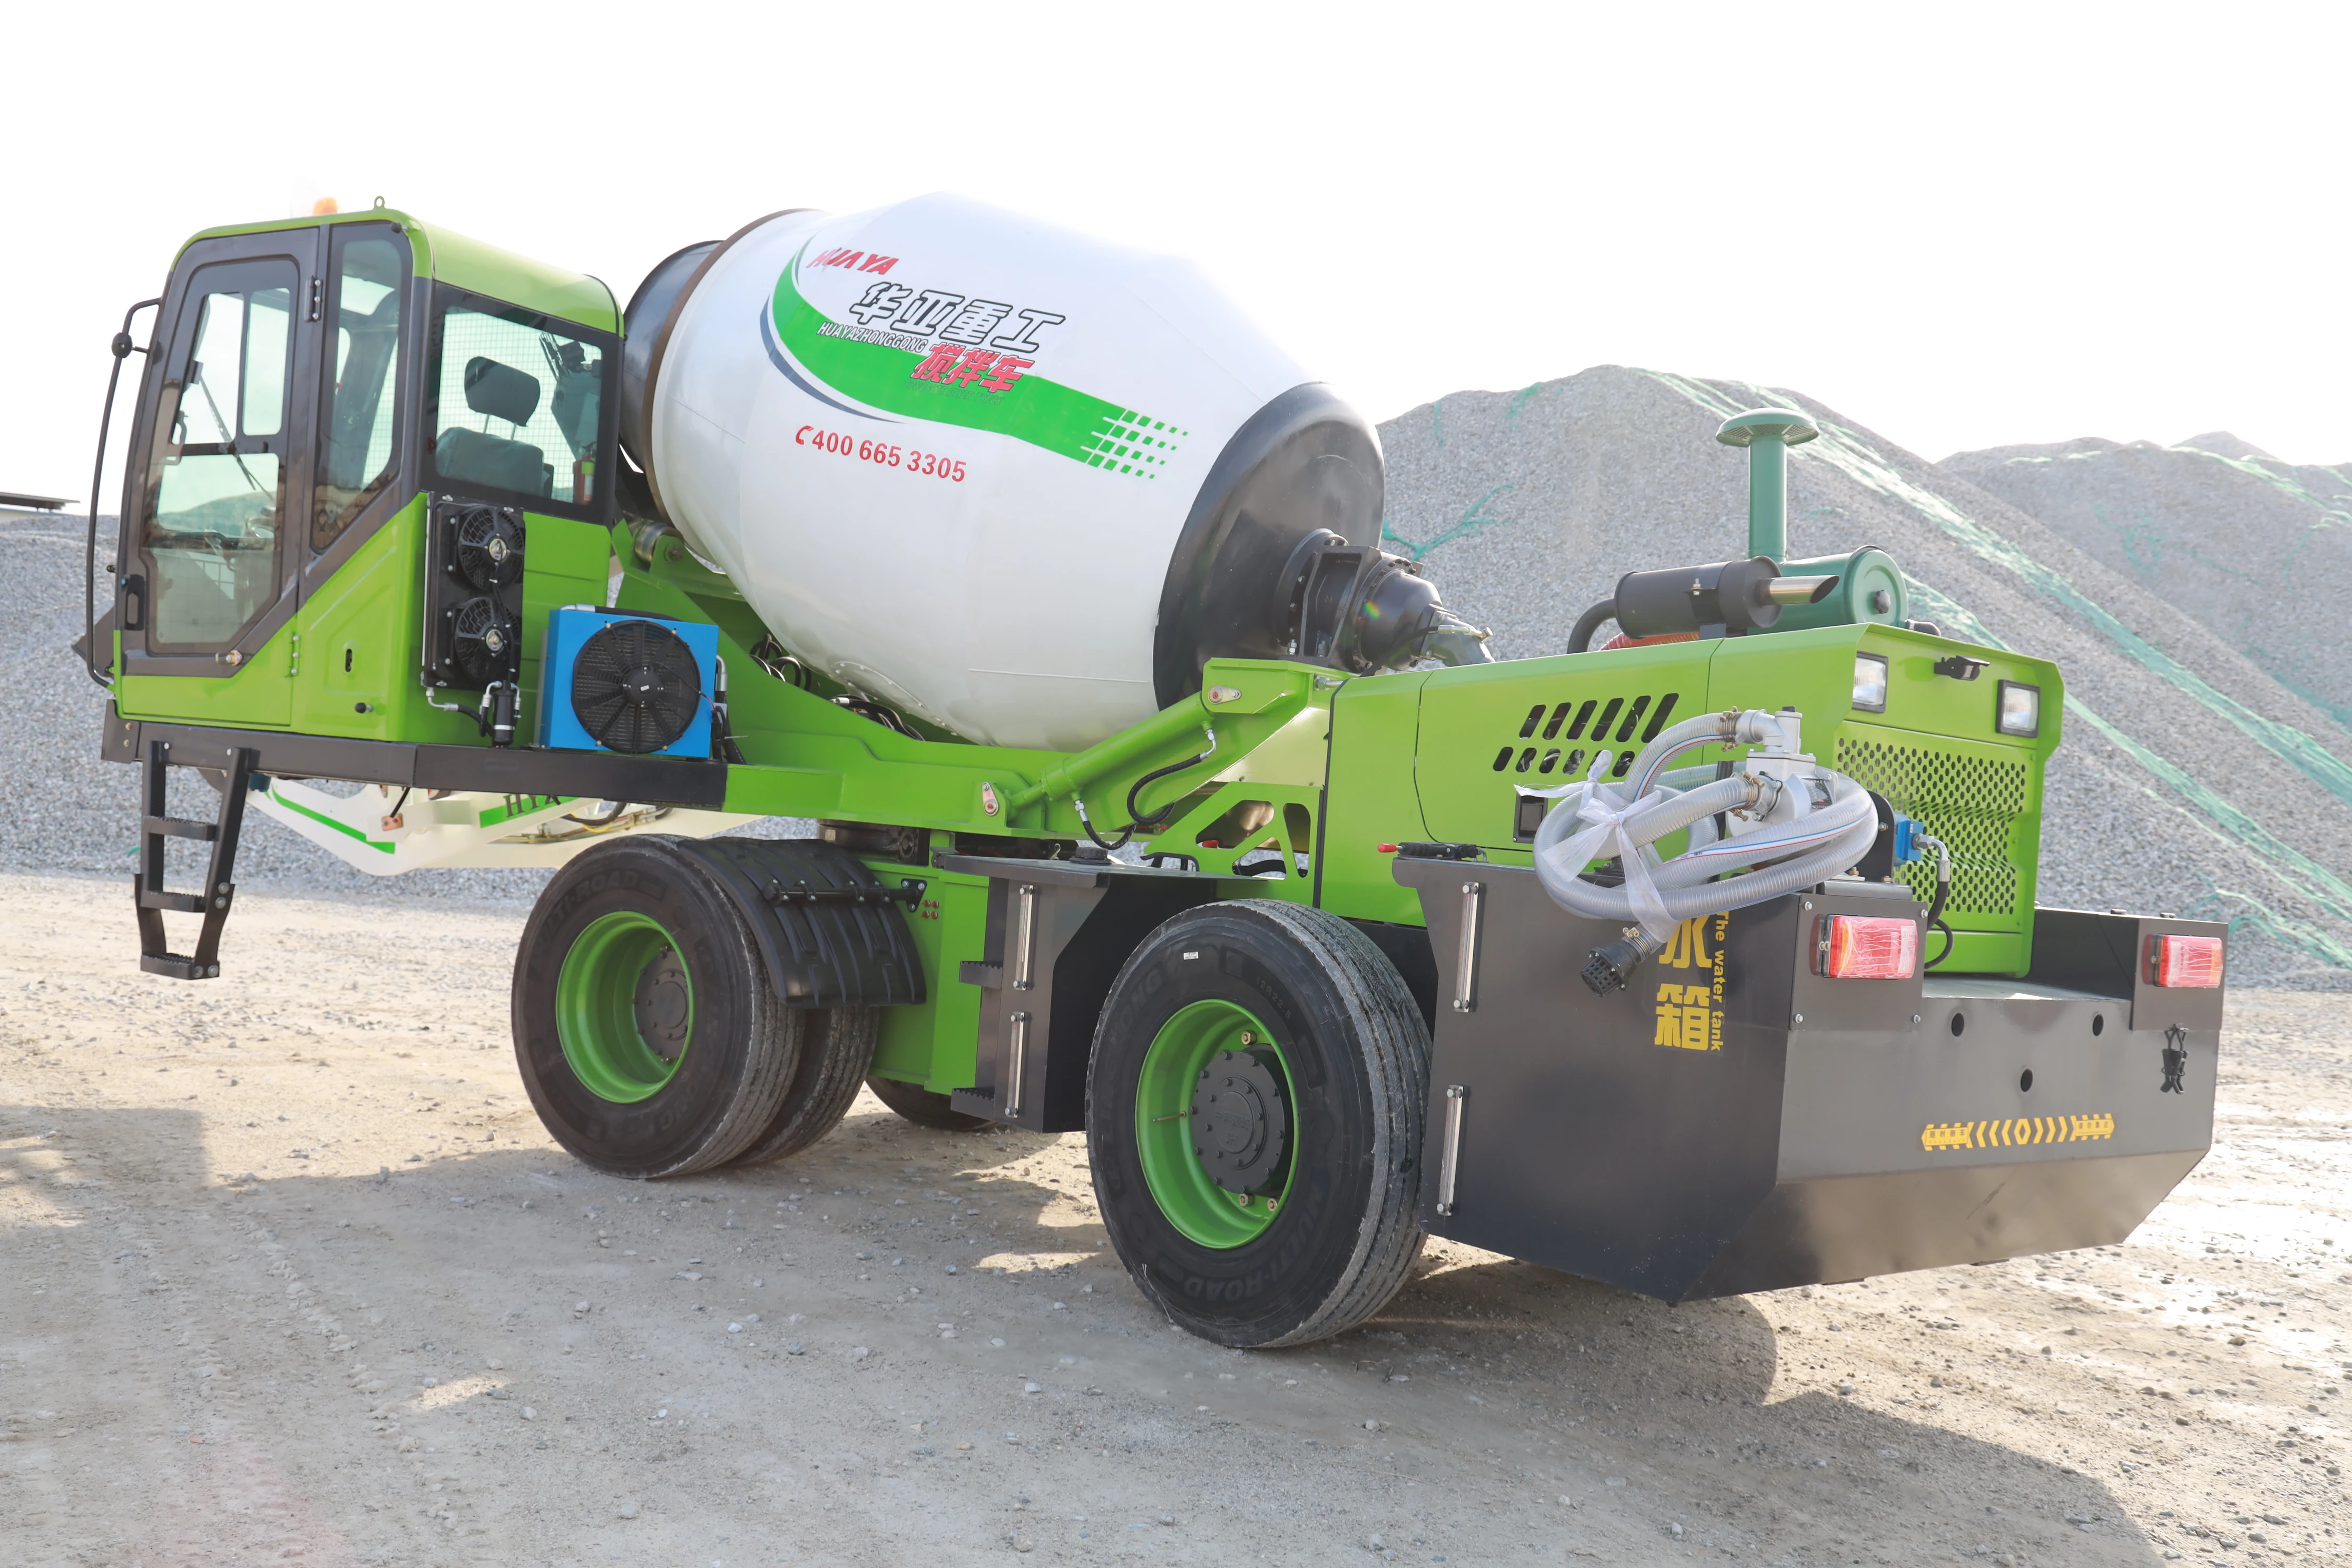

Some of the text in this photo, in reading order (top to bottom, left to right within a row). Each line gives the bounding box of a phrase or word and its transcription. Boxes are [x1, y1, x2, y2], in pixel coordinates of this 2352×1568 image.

[816, 321, 928, 352] HUAYAZHONGGONG
[849, 281, 1066, 353] 华亚重工
[910, 342, 1035, 393] 搅拌车
[812, 430, 966, 482] 400 665 3305
[1257, 976, 1291, 1020] 12R22.5
[1711, 911, 1729, 1051] The water tank
[1184, 1181, 1322, 1301] MULTI-ROAD
